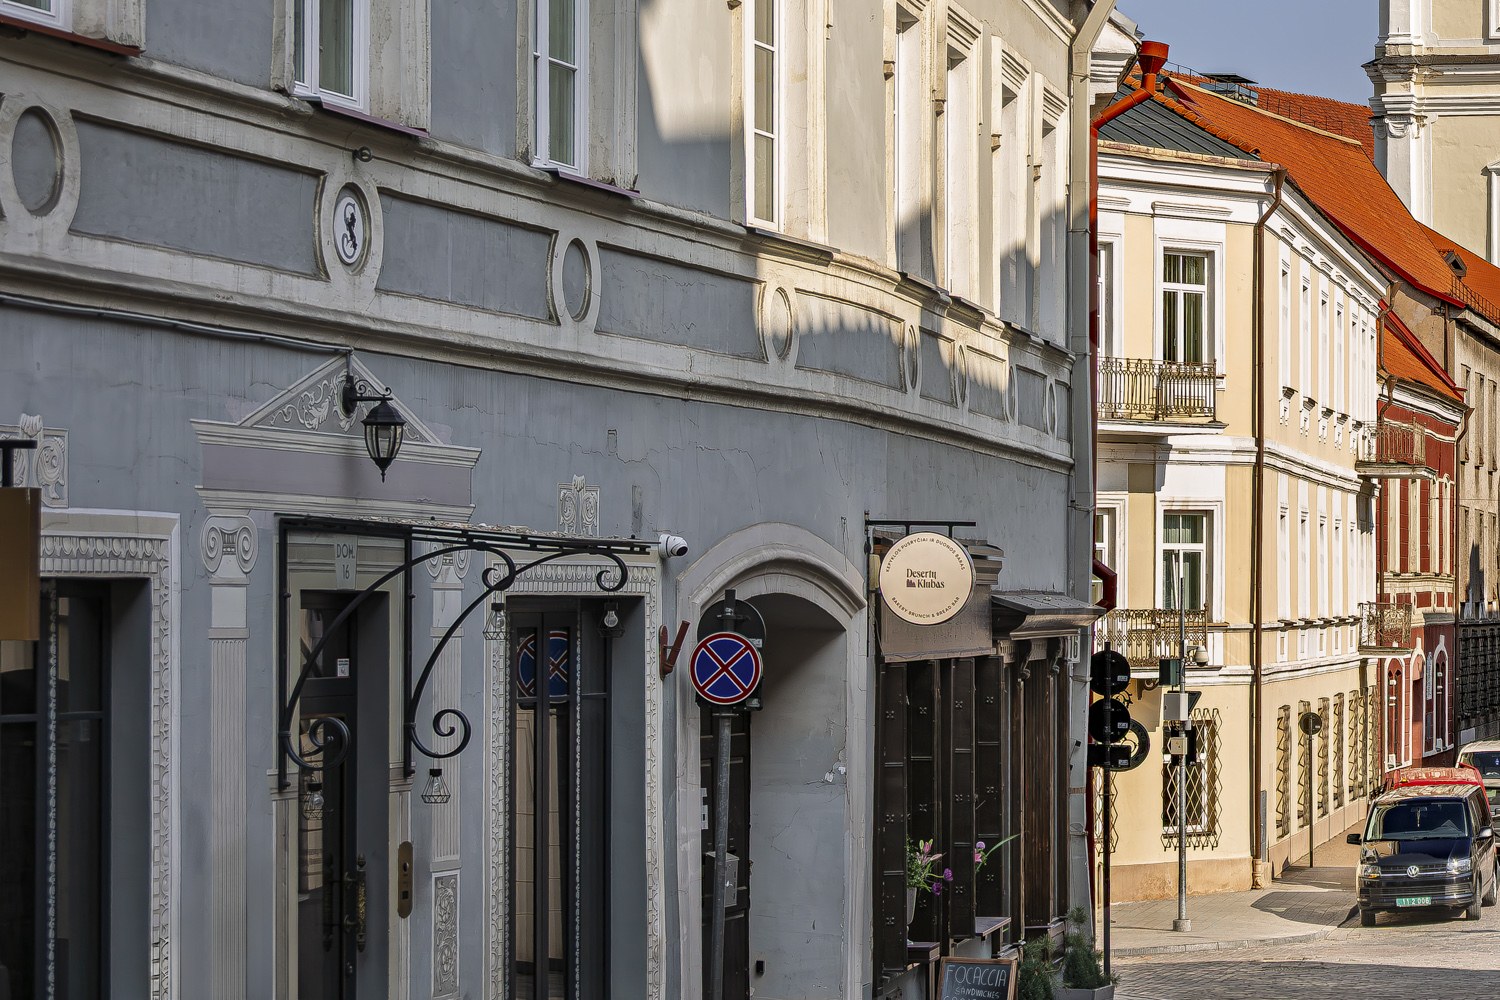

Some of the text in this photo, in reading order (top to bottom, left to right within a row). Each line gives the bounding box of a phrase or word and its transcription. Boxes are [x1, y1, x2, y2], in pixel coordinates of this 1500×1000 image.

[886, 549, 901, 573] KEPYKLOS
[901, 537, 928, 550] PUSRYČIAI
[936, 539, 956, 554] DUONOS
[954, 553, 966, 571] BARAS
[342, 564, 350, 580] 16
[917, 579, 945, 589] Klubas
[892, 596, 907, 613] BAKERY
[908, 610, 930, 619] BRUNCH
[936, 605, 952, 616] BREAD
[952, 596, 960, 606] BAR
[945, 964, 1007, 987] FOCACCIA
[955, 986, 1000, 999] SANDWICHES
